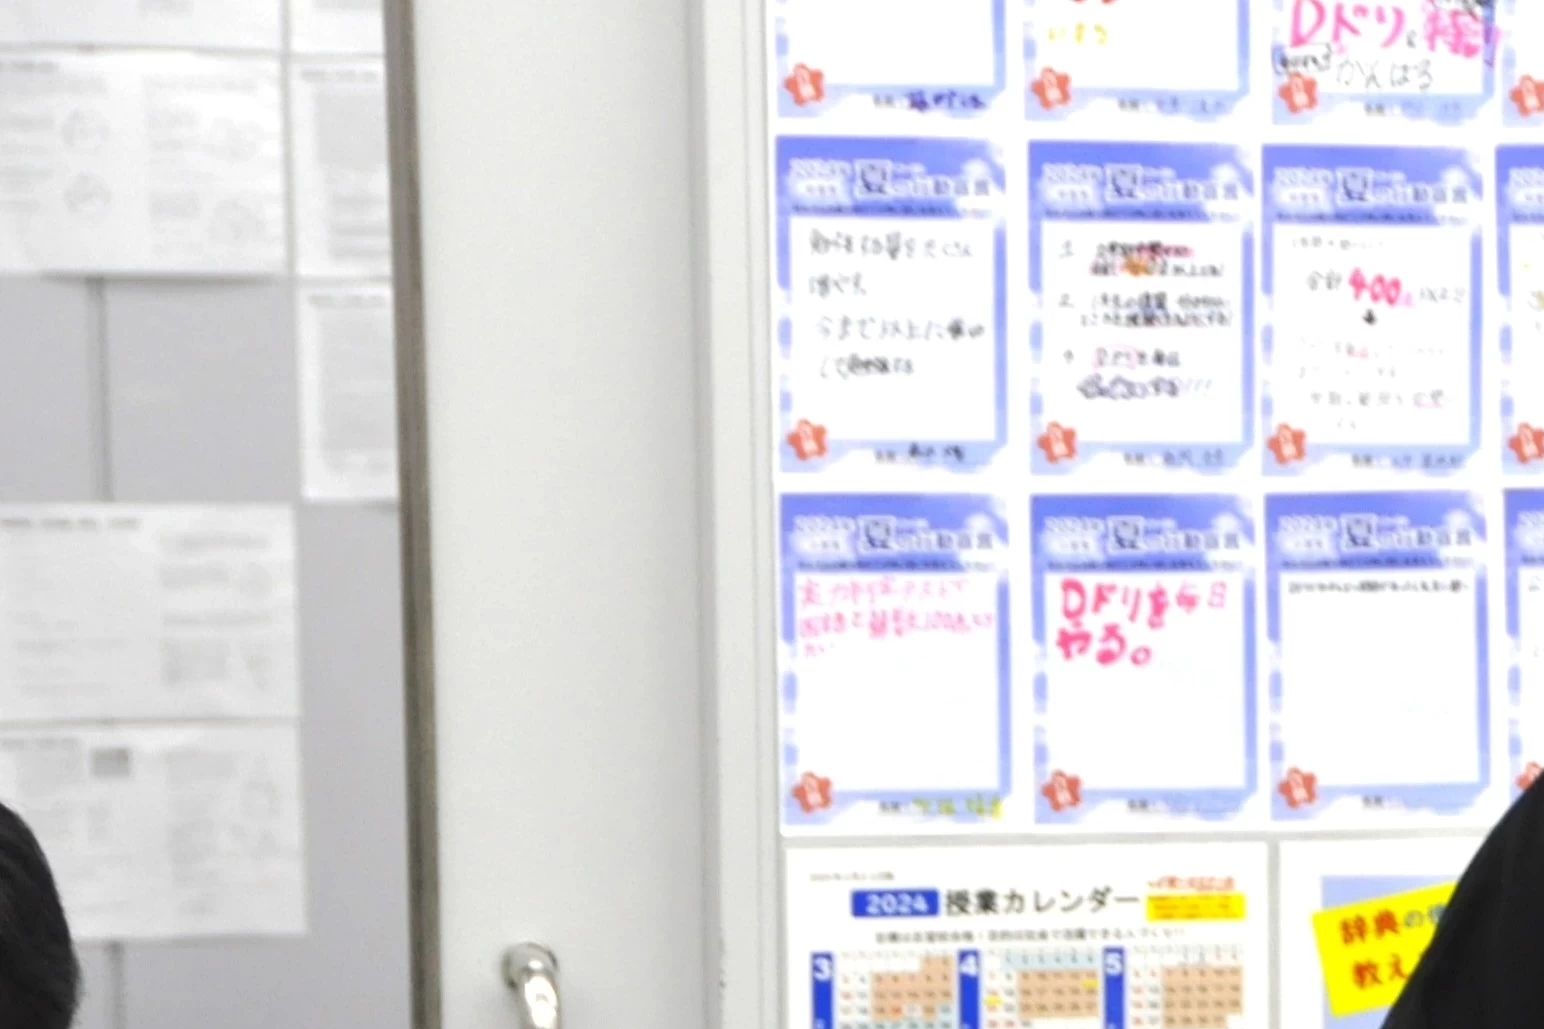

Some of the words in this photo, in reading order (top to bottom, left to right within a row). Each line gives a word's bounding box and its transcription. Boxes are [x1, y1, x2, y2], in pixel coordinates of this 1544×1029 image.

[866, 894, 930, 915] 2024
[944, 887, 1140, 917] 授業カレンダー
